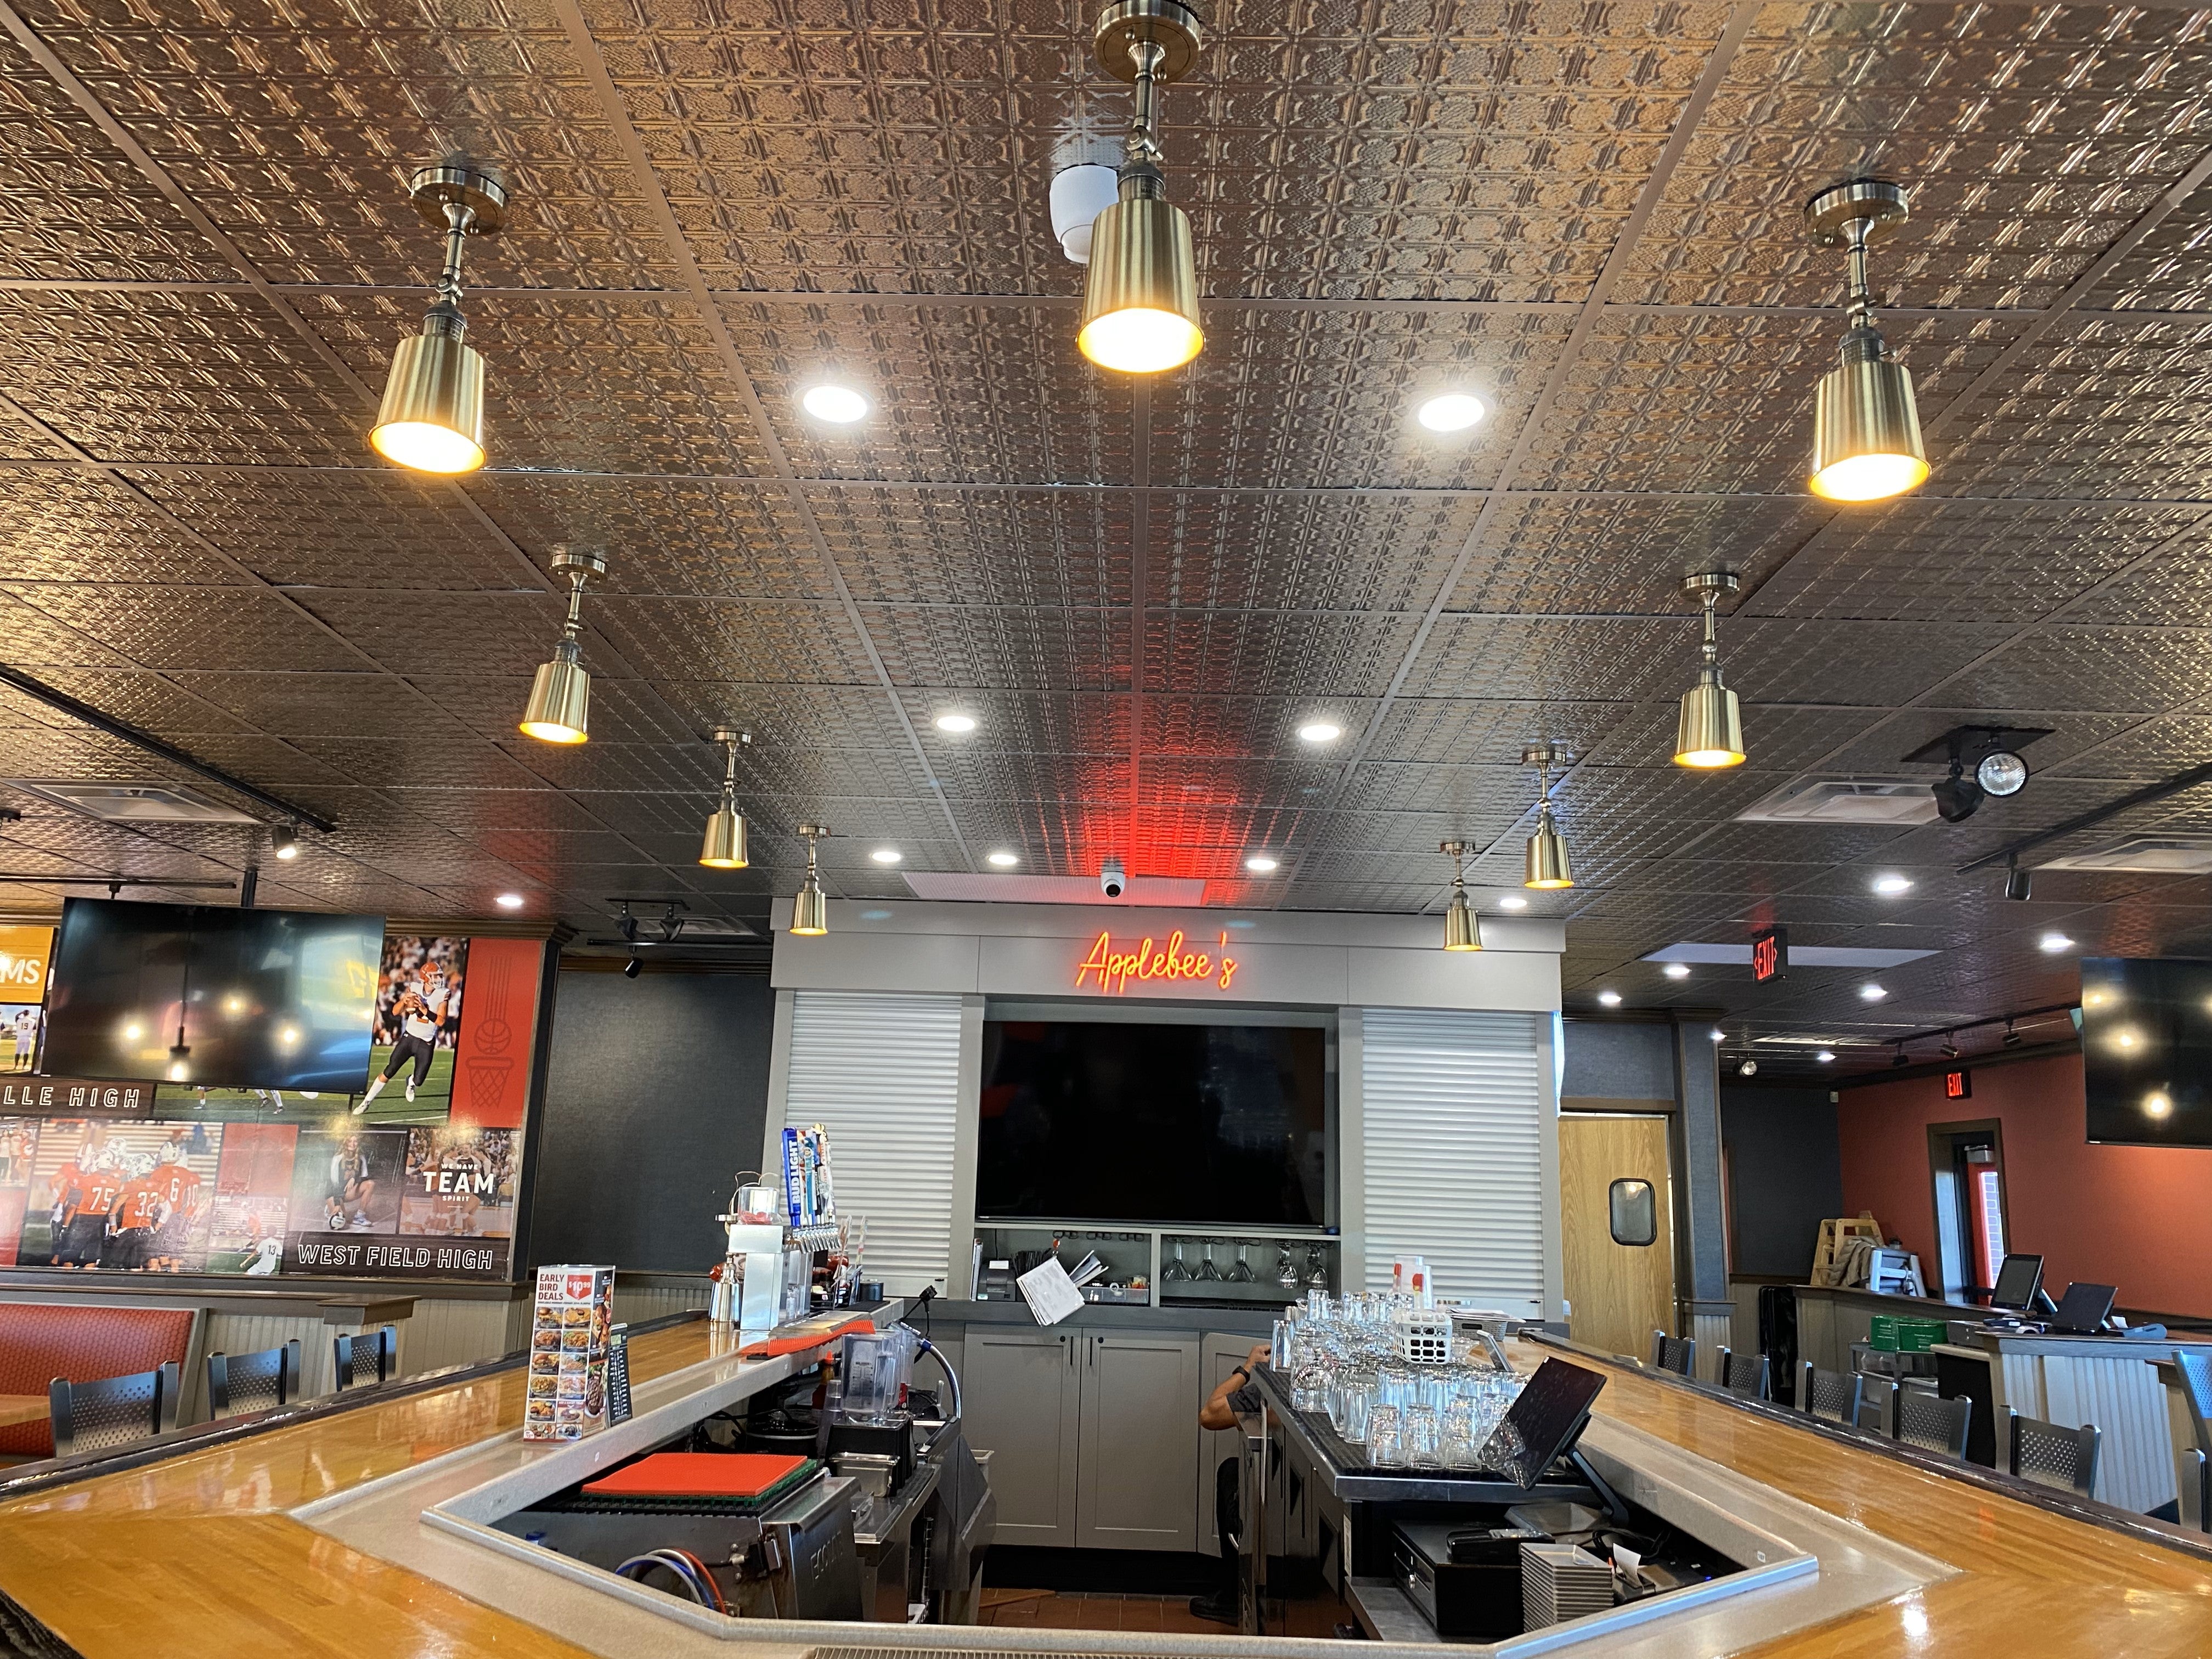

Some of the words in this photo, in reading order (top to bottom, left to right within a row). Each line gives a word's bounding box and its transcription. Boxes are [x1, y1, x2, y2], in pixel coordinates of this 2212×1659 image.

[1075, 930, 1238, 994] Applebee's
[1757, 935, 1775, 980] EXIT
[1948, 1073, 1963, 1096] EXIT
[3, 1086, 54, 1106] LLE
[69, 1087, 139, 1108] HIGH
[788, 1139, 799, 1176] LIGHT
[170, 1178, 180, 1202] 6
[422, 1171, 494, 1194] TEAM
[791, 1177, 801, 1204] BUD
[89, 1187, 115, 1212] 75
[134, 1191, 159, 1217] 32
[268, 1245, 276, 1255] 13
[298, 1245, 360, 1266] WEST
[366, 1246, 431, 1267] FIELD
[437, 1249, 493, 1269] HIGH
[540, 1274, 565, 1282] EARLY
[538, 1292, 563, 1300] DEALS
